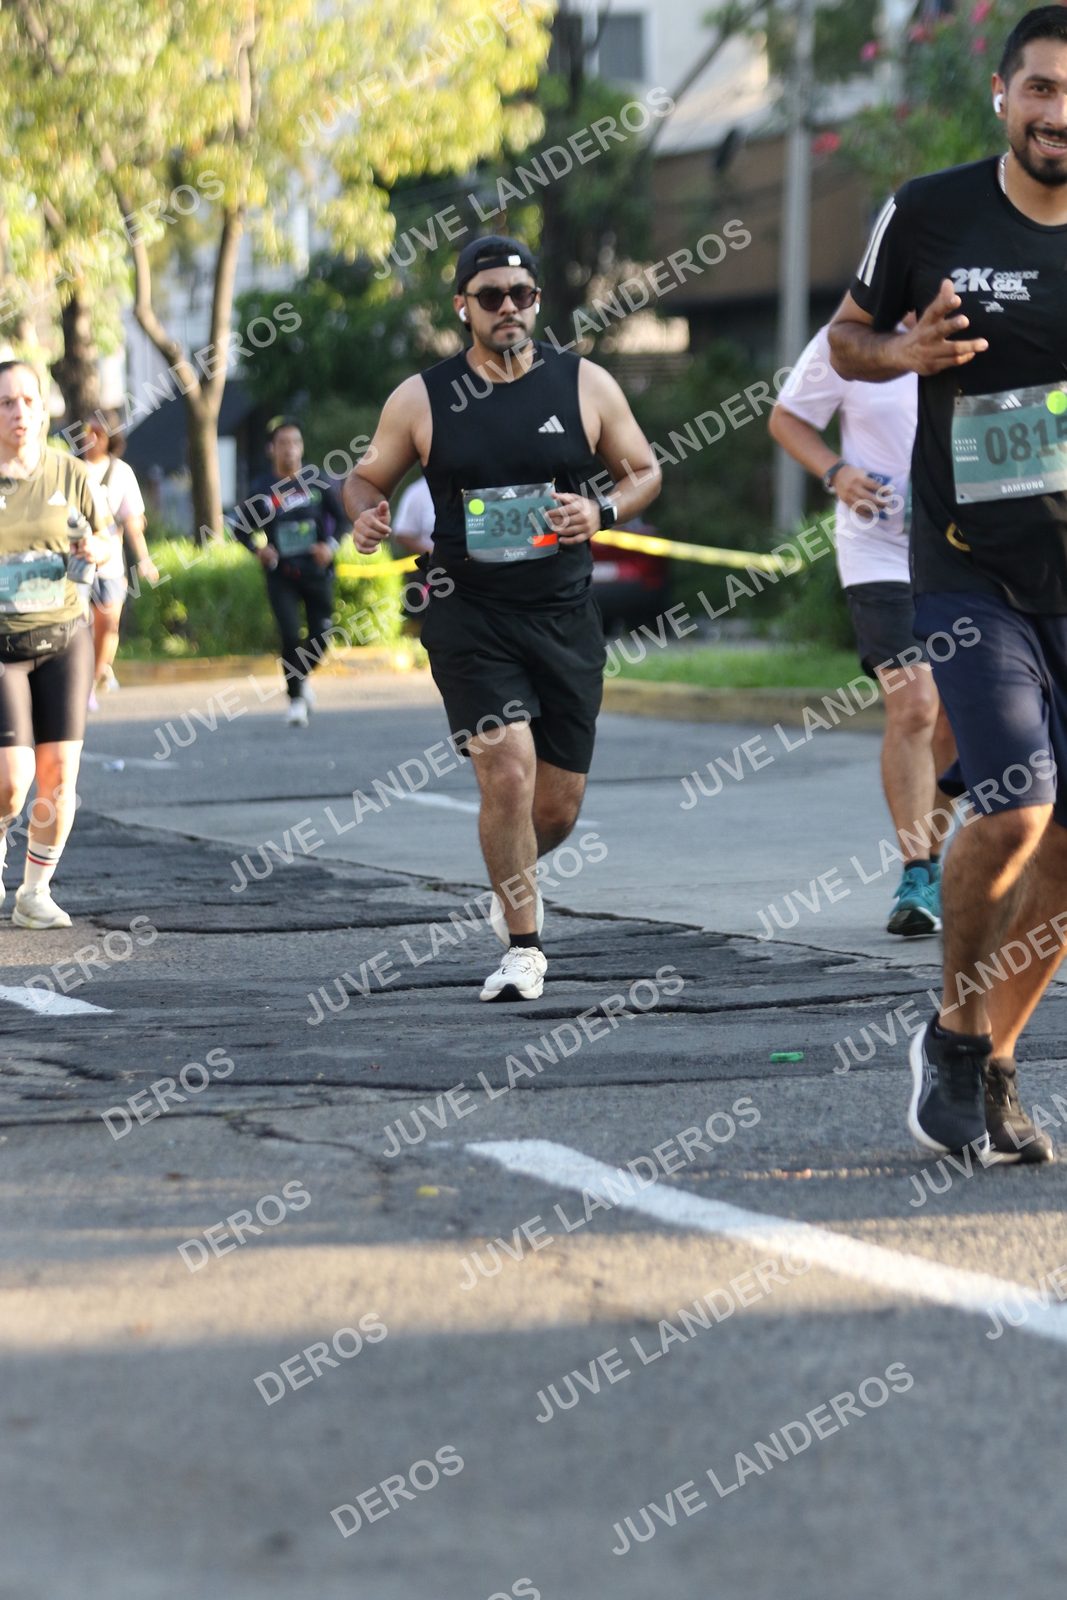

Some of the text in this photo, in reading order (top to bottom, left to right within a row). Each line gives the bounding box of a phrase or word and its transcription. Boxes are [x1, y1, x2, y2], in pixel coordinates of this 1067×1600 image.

[951, 267, 993, 292] 2K
[992, 280, 1028, 292] GDL
[1001, 480, 1045, 493] SAMSUNG
